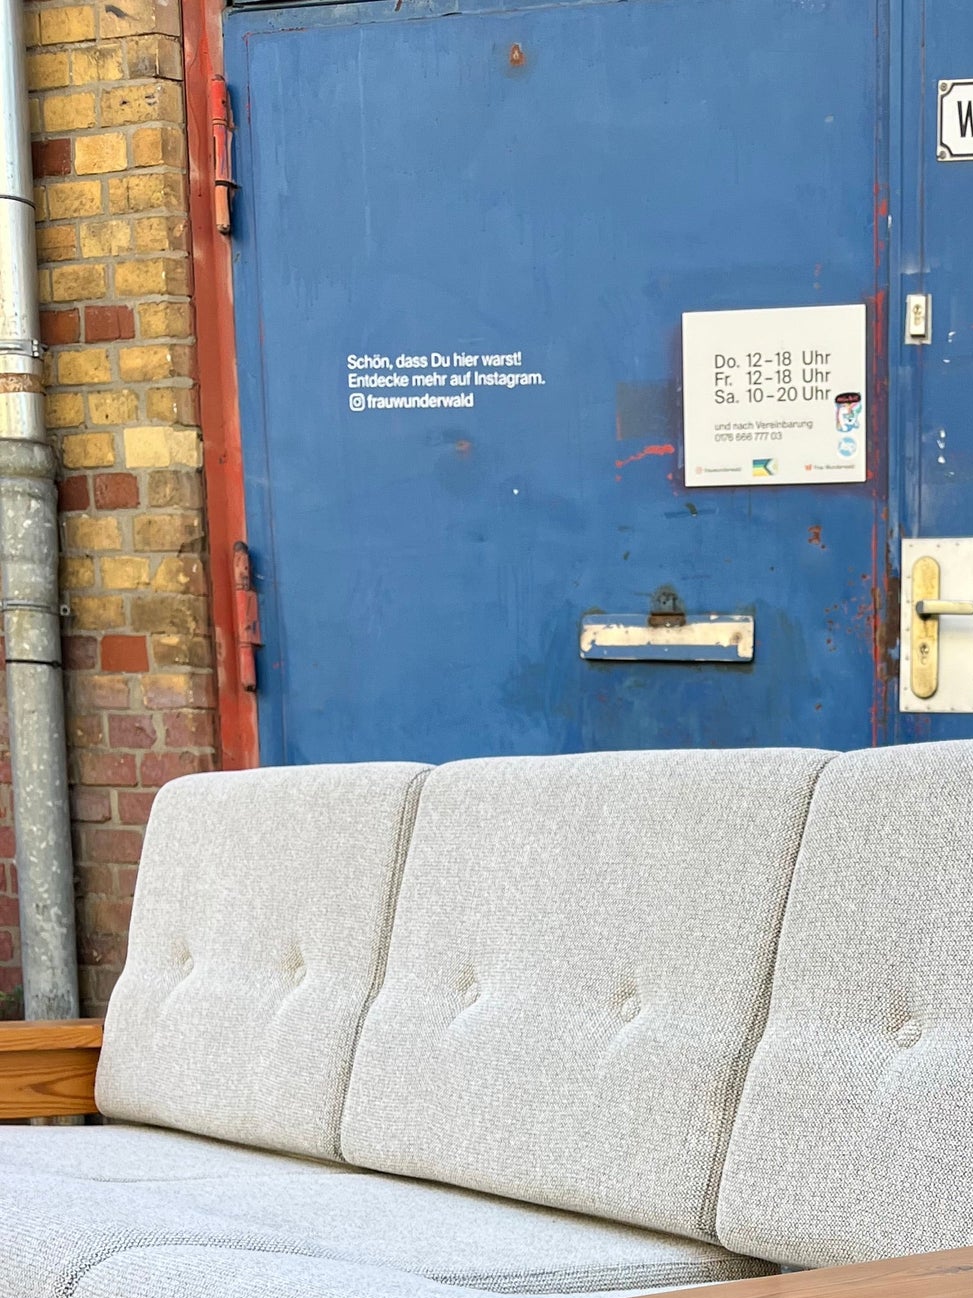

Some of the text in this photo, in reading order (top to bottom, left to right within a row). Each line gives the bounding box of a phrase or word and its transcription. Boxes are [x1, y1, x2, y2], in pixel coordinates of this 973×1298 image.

[347, 352, 522, 370] Schön, dass Du hier warst!
[714, 354, 740, 369] Do.
[802, 350, 831, 366] Uhr
[348, 371, 546, 388] Entdecke mehr auf Instagram.
[714, 371, 733, 386] Fr.
[802, 368, 831, 383] Uhr
[367, 393, 474, 409] frauwunderwald
[714, 389, 740, 404] Sa.
[802, 385, 831, 400] Uhr
[714, 420, 813, 431] und nach Vereinbarung
